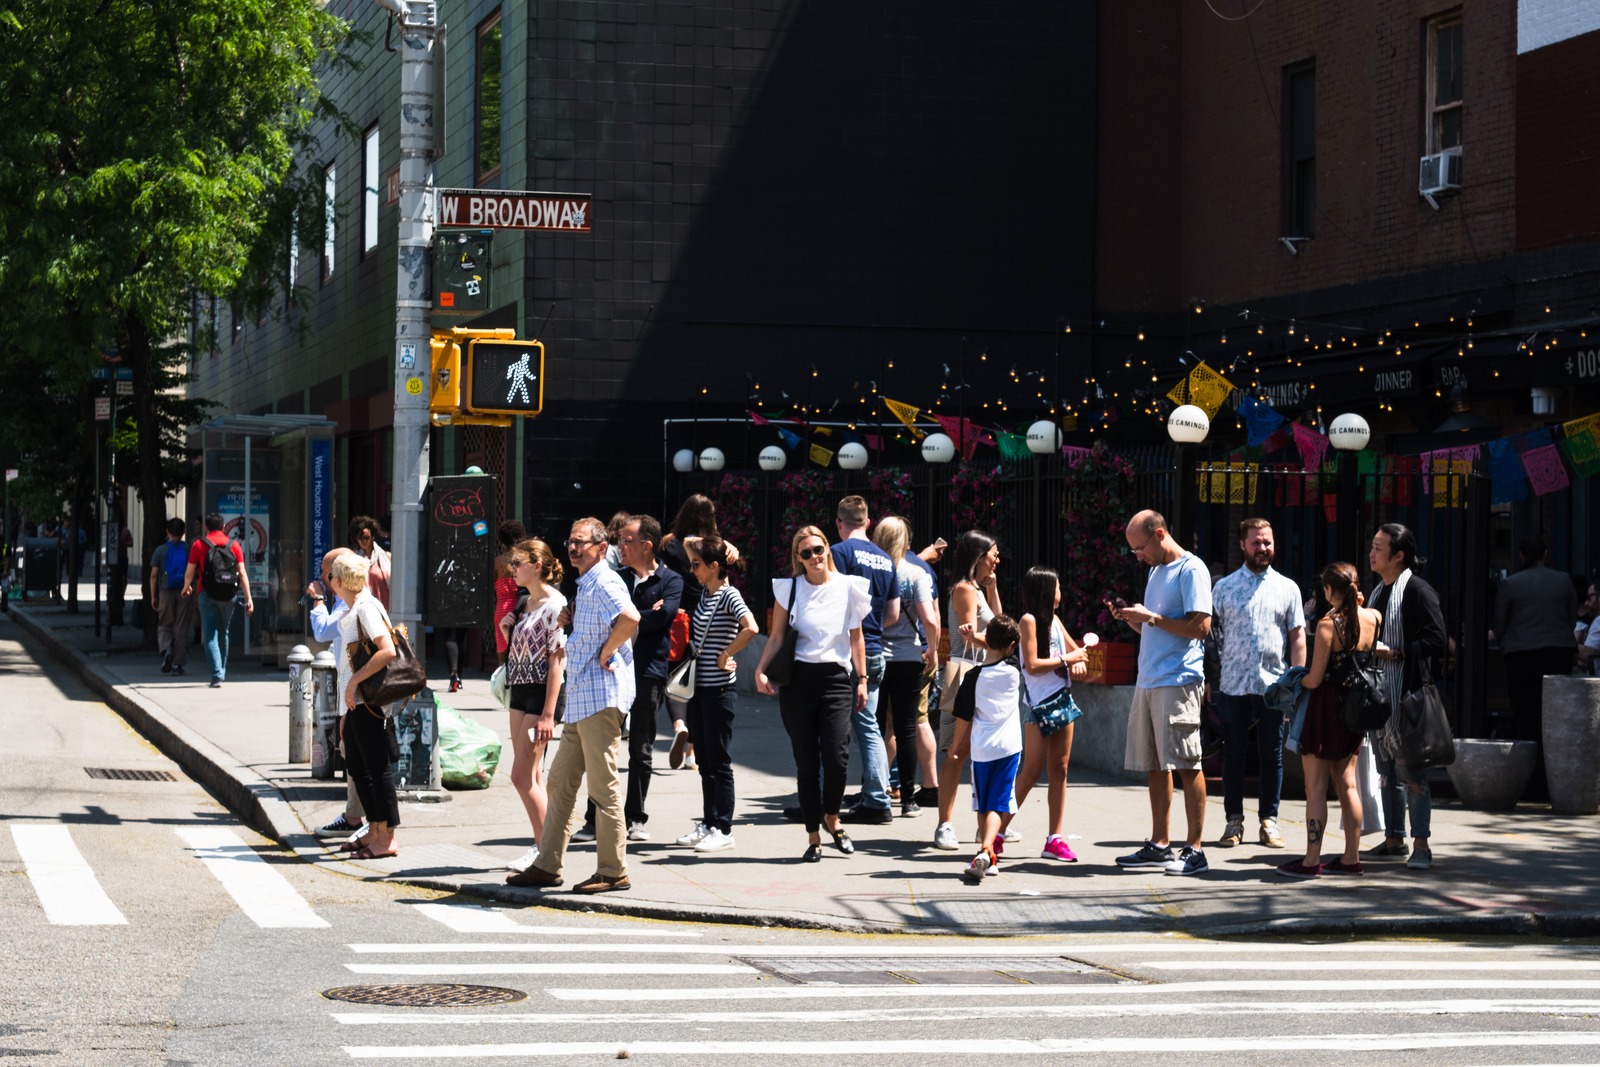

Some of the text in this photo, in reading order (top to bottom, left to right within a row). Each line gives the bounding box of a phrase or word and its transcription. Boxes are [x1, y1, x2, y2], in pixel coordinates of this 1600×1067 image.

[441, 196, 459, 224] W
[469, 197, 588, 229] BROADWAY
[1374, 370, 1412, 392] DINNER
[1175, 419, 1205, 430] CAMINOS
[1338, 427, 1368, 435] CAMINOS
[314, 455, 324, 478] West
[314, 480, 324, 517] Houston
[314, 519, 324, 545] Street
[314, 556, 324, 578] West
